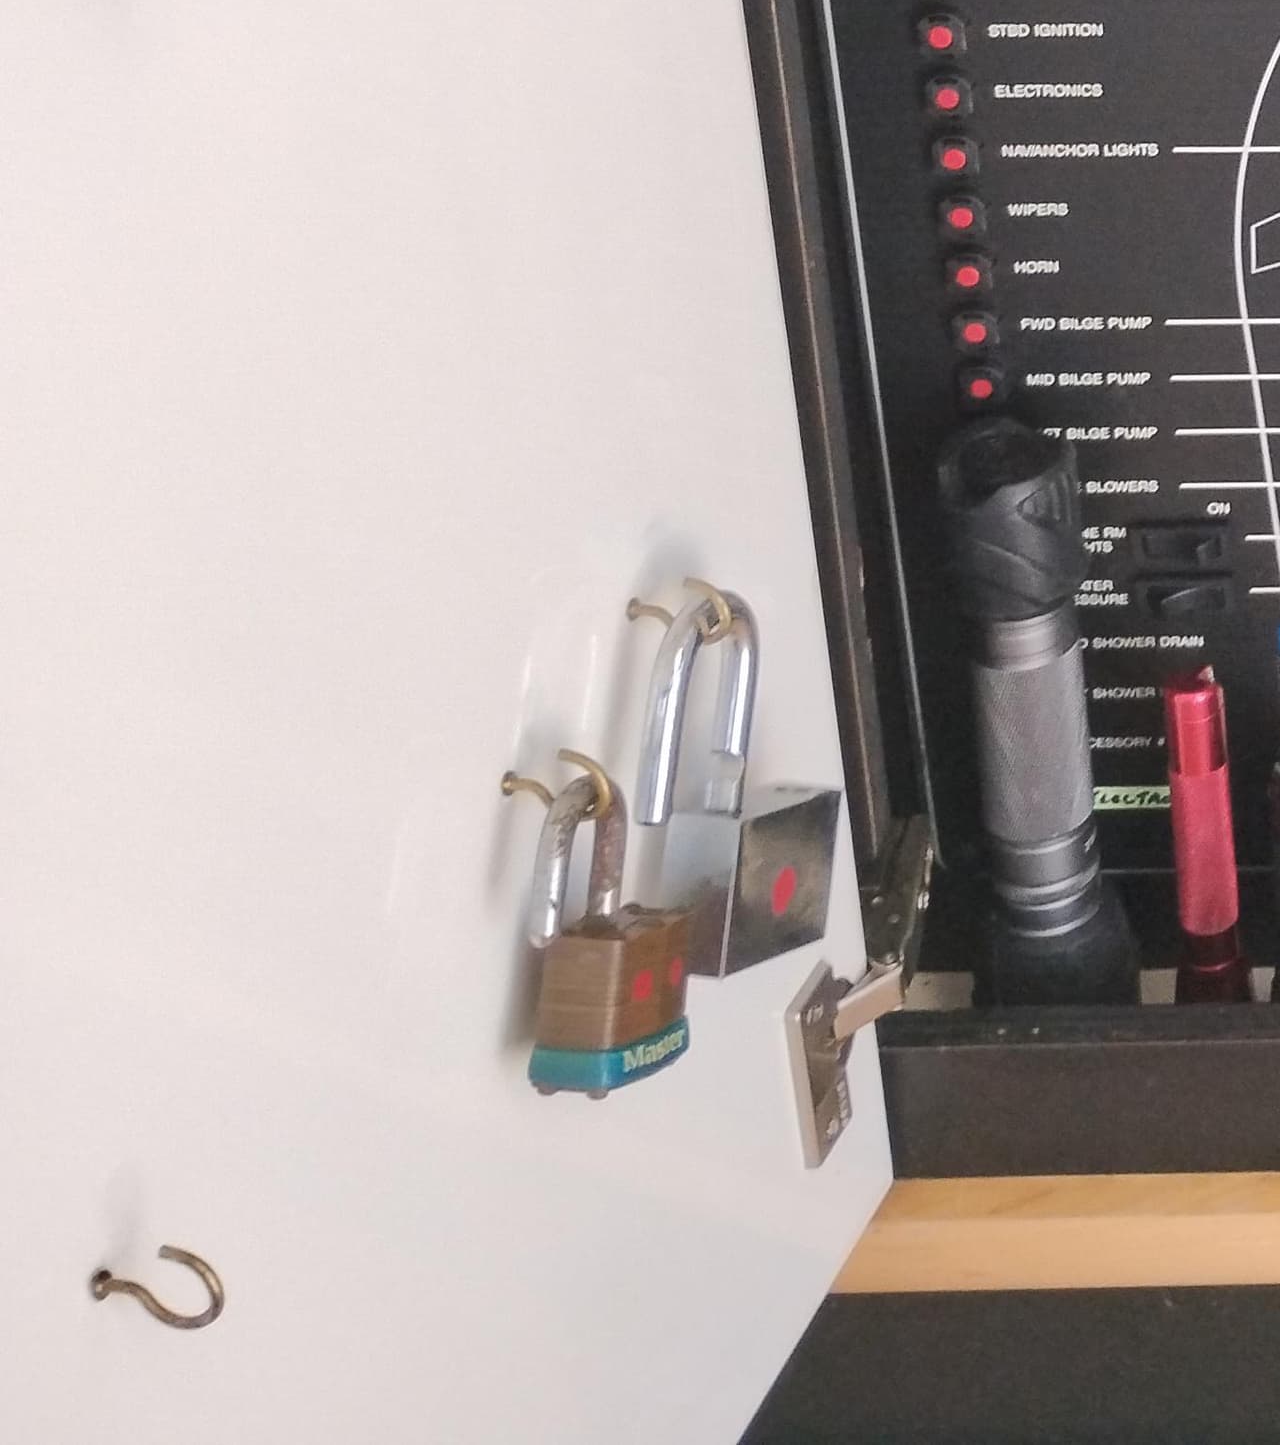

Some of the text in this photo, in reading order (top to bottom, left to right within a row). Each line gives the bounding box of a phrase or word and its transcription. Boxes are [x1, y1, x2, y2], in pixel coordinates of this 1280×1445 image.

[988, 23, 1103, 37] STBD IGNITION
[994, 84, 1103, 98] ELECTRONICS
[1001, 143, 1159, 157] NAV/ANCHOR LIGHTS
[1008, 203, 1068, 216] WIPERS
[1014, 261, 1059, 273] HORN
[1020, 317, 1152, 330] FWD BILGE PUMP
[1207, 502, 1230, 514] ON
[1092, 637, 1156, 648] SHOWER
[1159, 635, 1205, 649] DRAIN
[622, 1027, 687, 1073] Master
